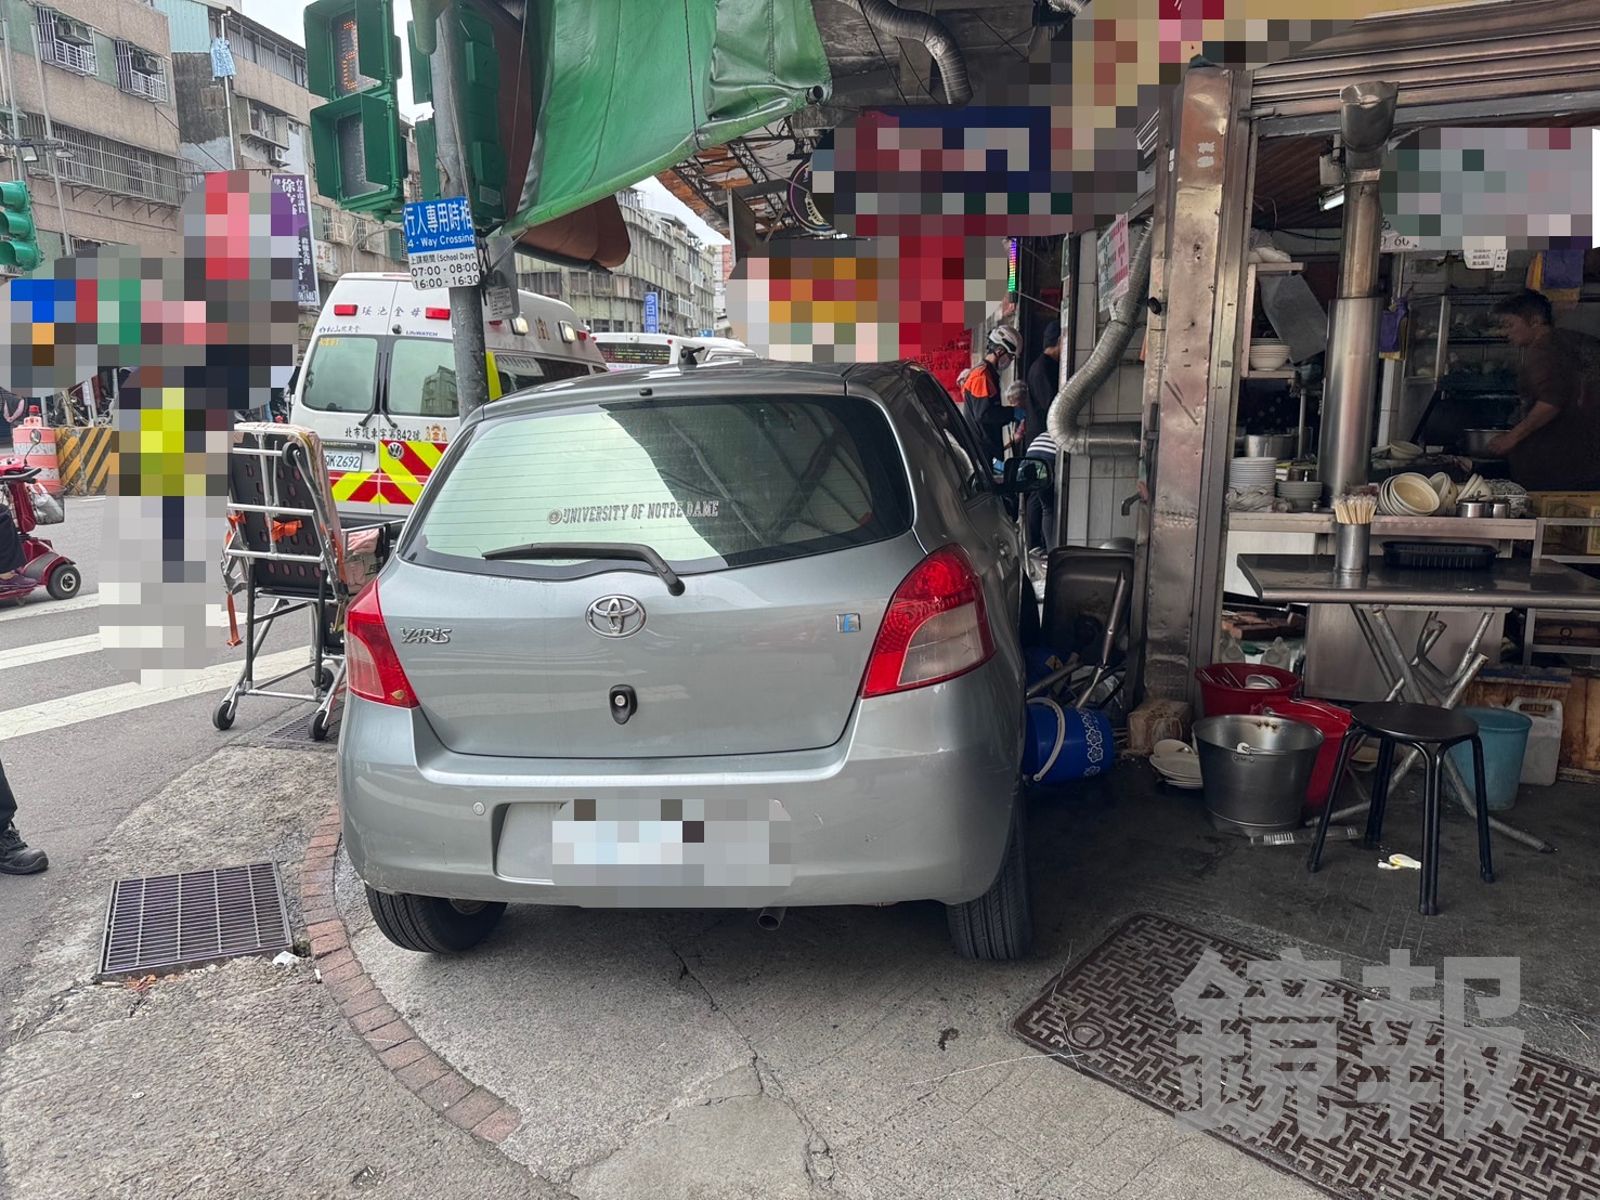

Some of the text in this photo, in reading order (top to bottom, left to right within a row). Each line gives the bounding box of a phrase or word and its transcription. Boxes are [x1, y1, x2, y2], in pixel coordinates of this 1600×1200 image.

[403, 200, 473, 236] 行人專用時相
[440, 234, 475, 245] Crossing
[411, 265, 441, 277] 07:00
[449, 262, 478, 273] 08:00
[415, 277, 443, 288] 16:00
[452, 274, 480, 286] 16:30
[562, 500, 719, 524] UNIVERSITY OF NOTRE DAME
